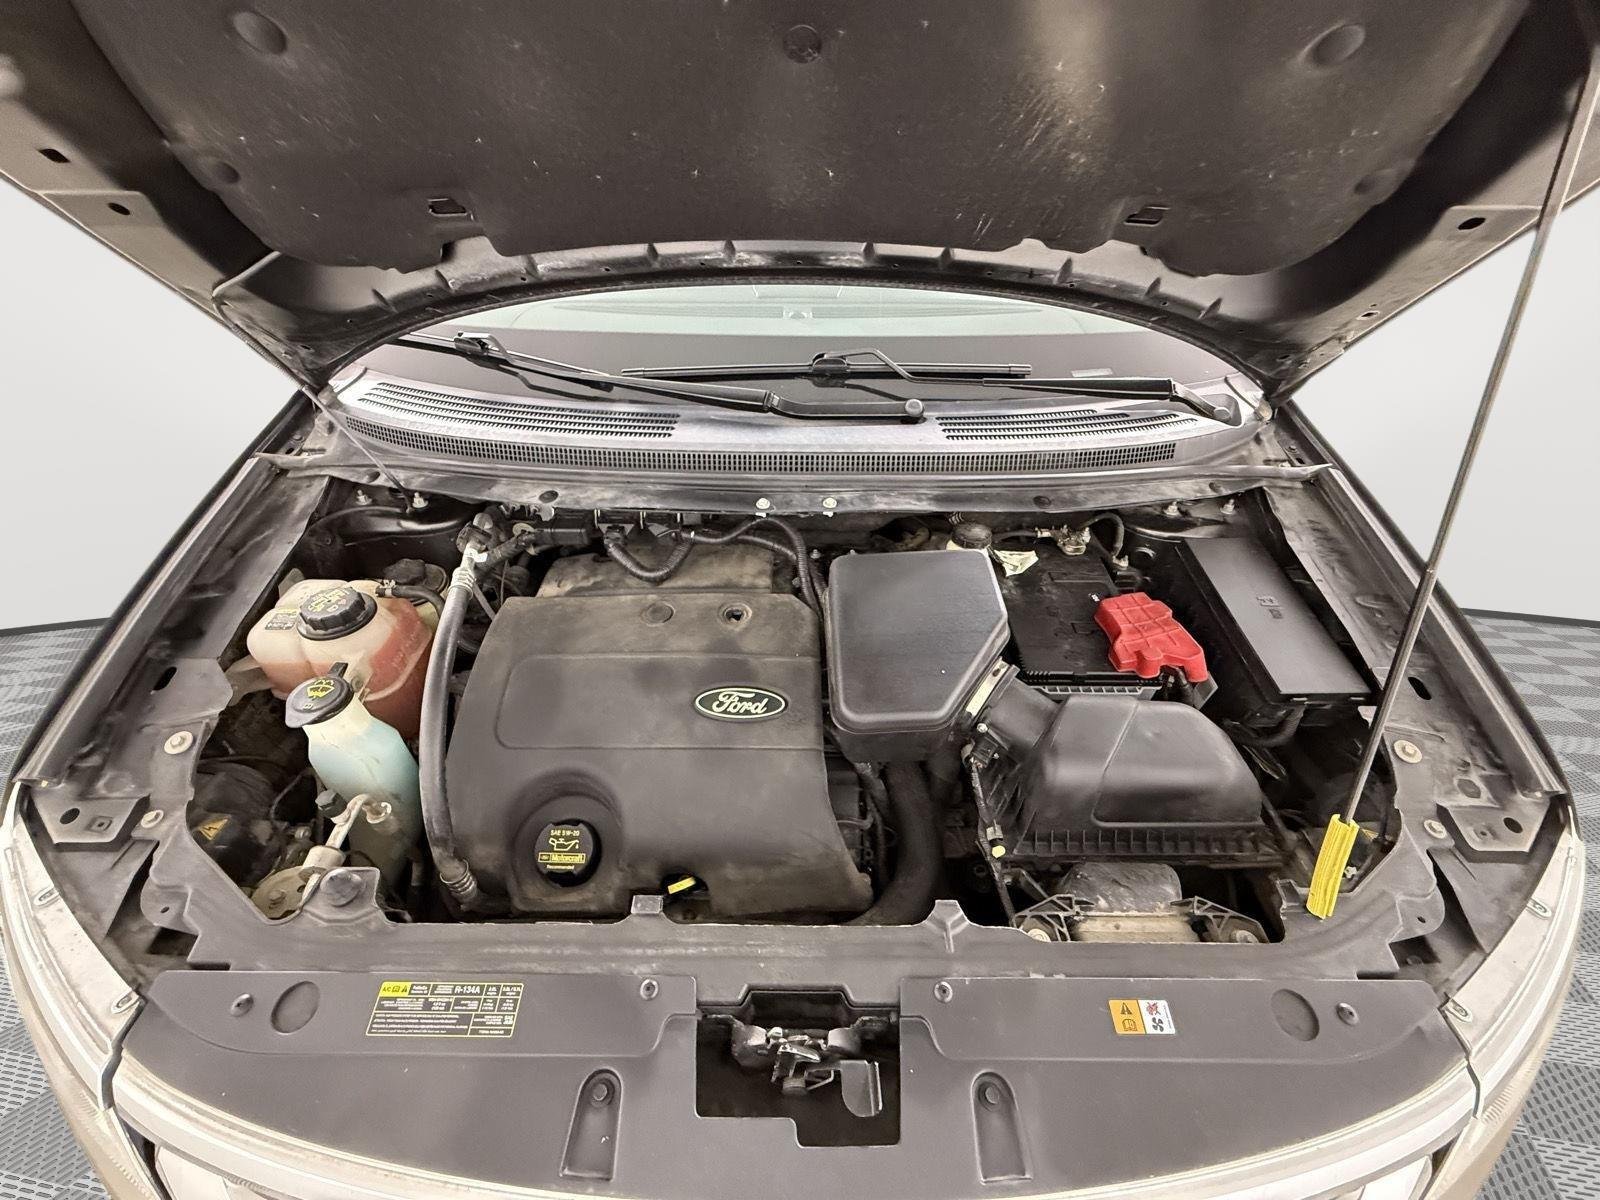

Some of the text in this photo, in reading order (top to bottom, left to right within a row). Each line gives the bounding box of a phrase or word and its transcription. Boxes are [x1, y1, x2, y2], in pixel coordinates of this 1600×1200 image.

[712, 690, 769, 714] Ford
[562, 829, 580, 837] 5W-20
[551, 853, 583, 863] Motorcraft
[454, 985, 481, 994] R-134A
